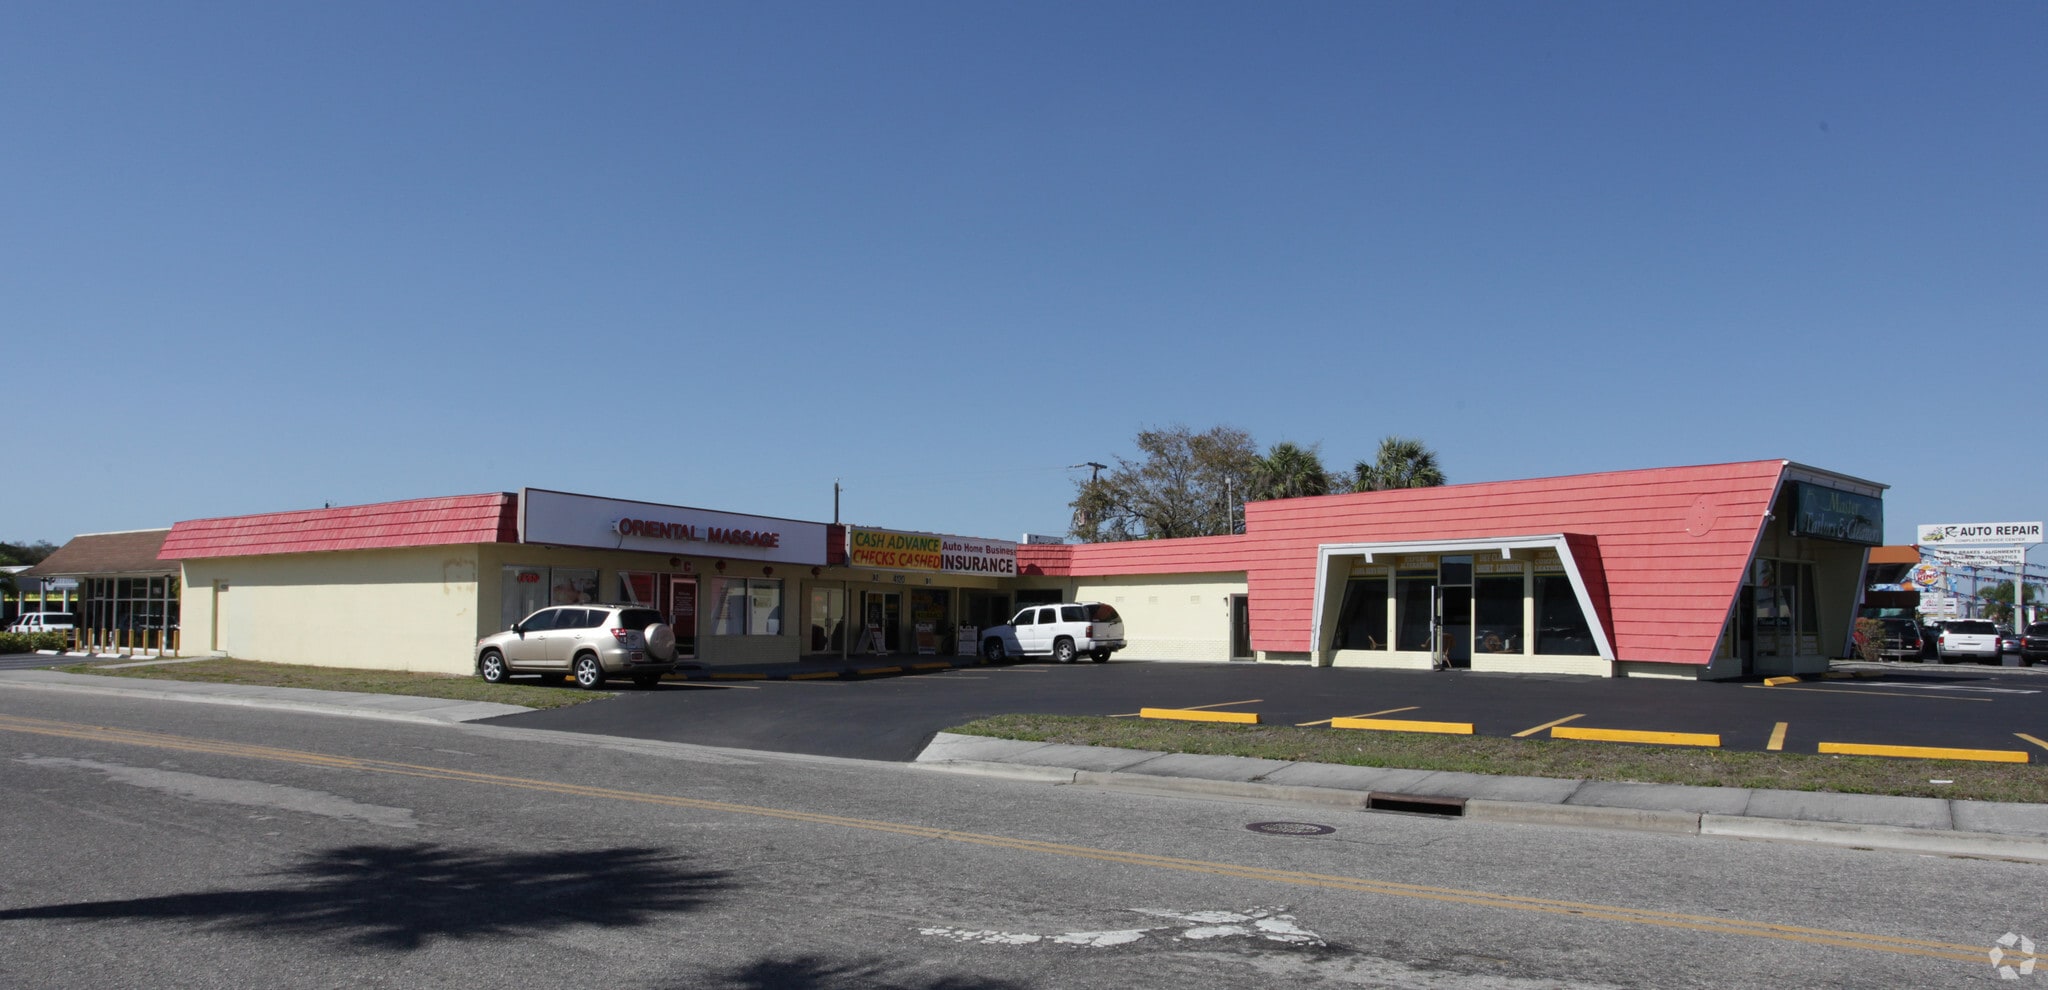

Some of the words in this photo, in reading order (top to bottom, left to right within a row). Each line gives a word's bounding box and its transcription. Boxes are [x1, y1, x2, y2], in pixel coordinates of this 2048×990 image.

[619, 518, 699, 541] ORIENTAL
[708, 527, 779, 548] MASSAGE
[1960, 526, 1992, 536] AUTO
[1996, 525, 2039, 536] REPAIR
[855, 532, 886, 548] CASH
[887, 534, 939, 552] ADVANCE
[942, 541, 962, 551] Auto
[964, 543, 983, 553] Home
[986, 545, 1017, 556] Business
[683, 561, 692, 572] C
[853, 550, 896, 566] CHECKS
[900, 552, 940, 569] CASHED
[941, 555, 1013, 573] INSURANCE
